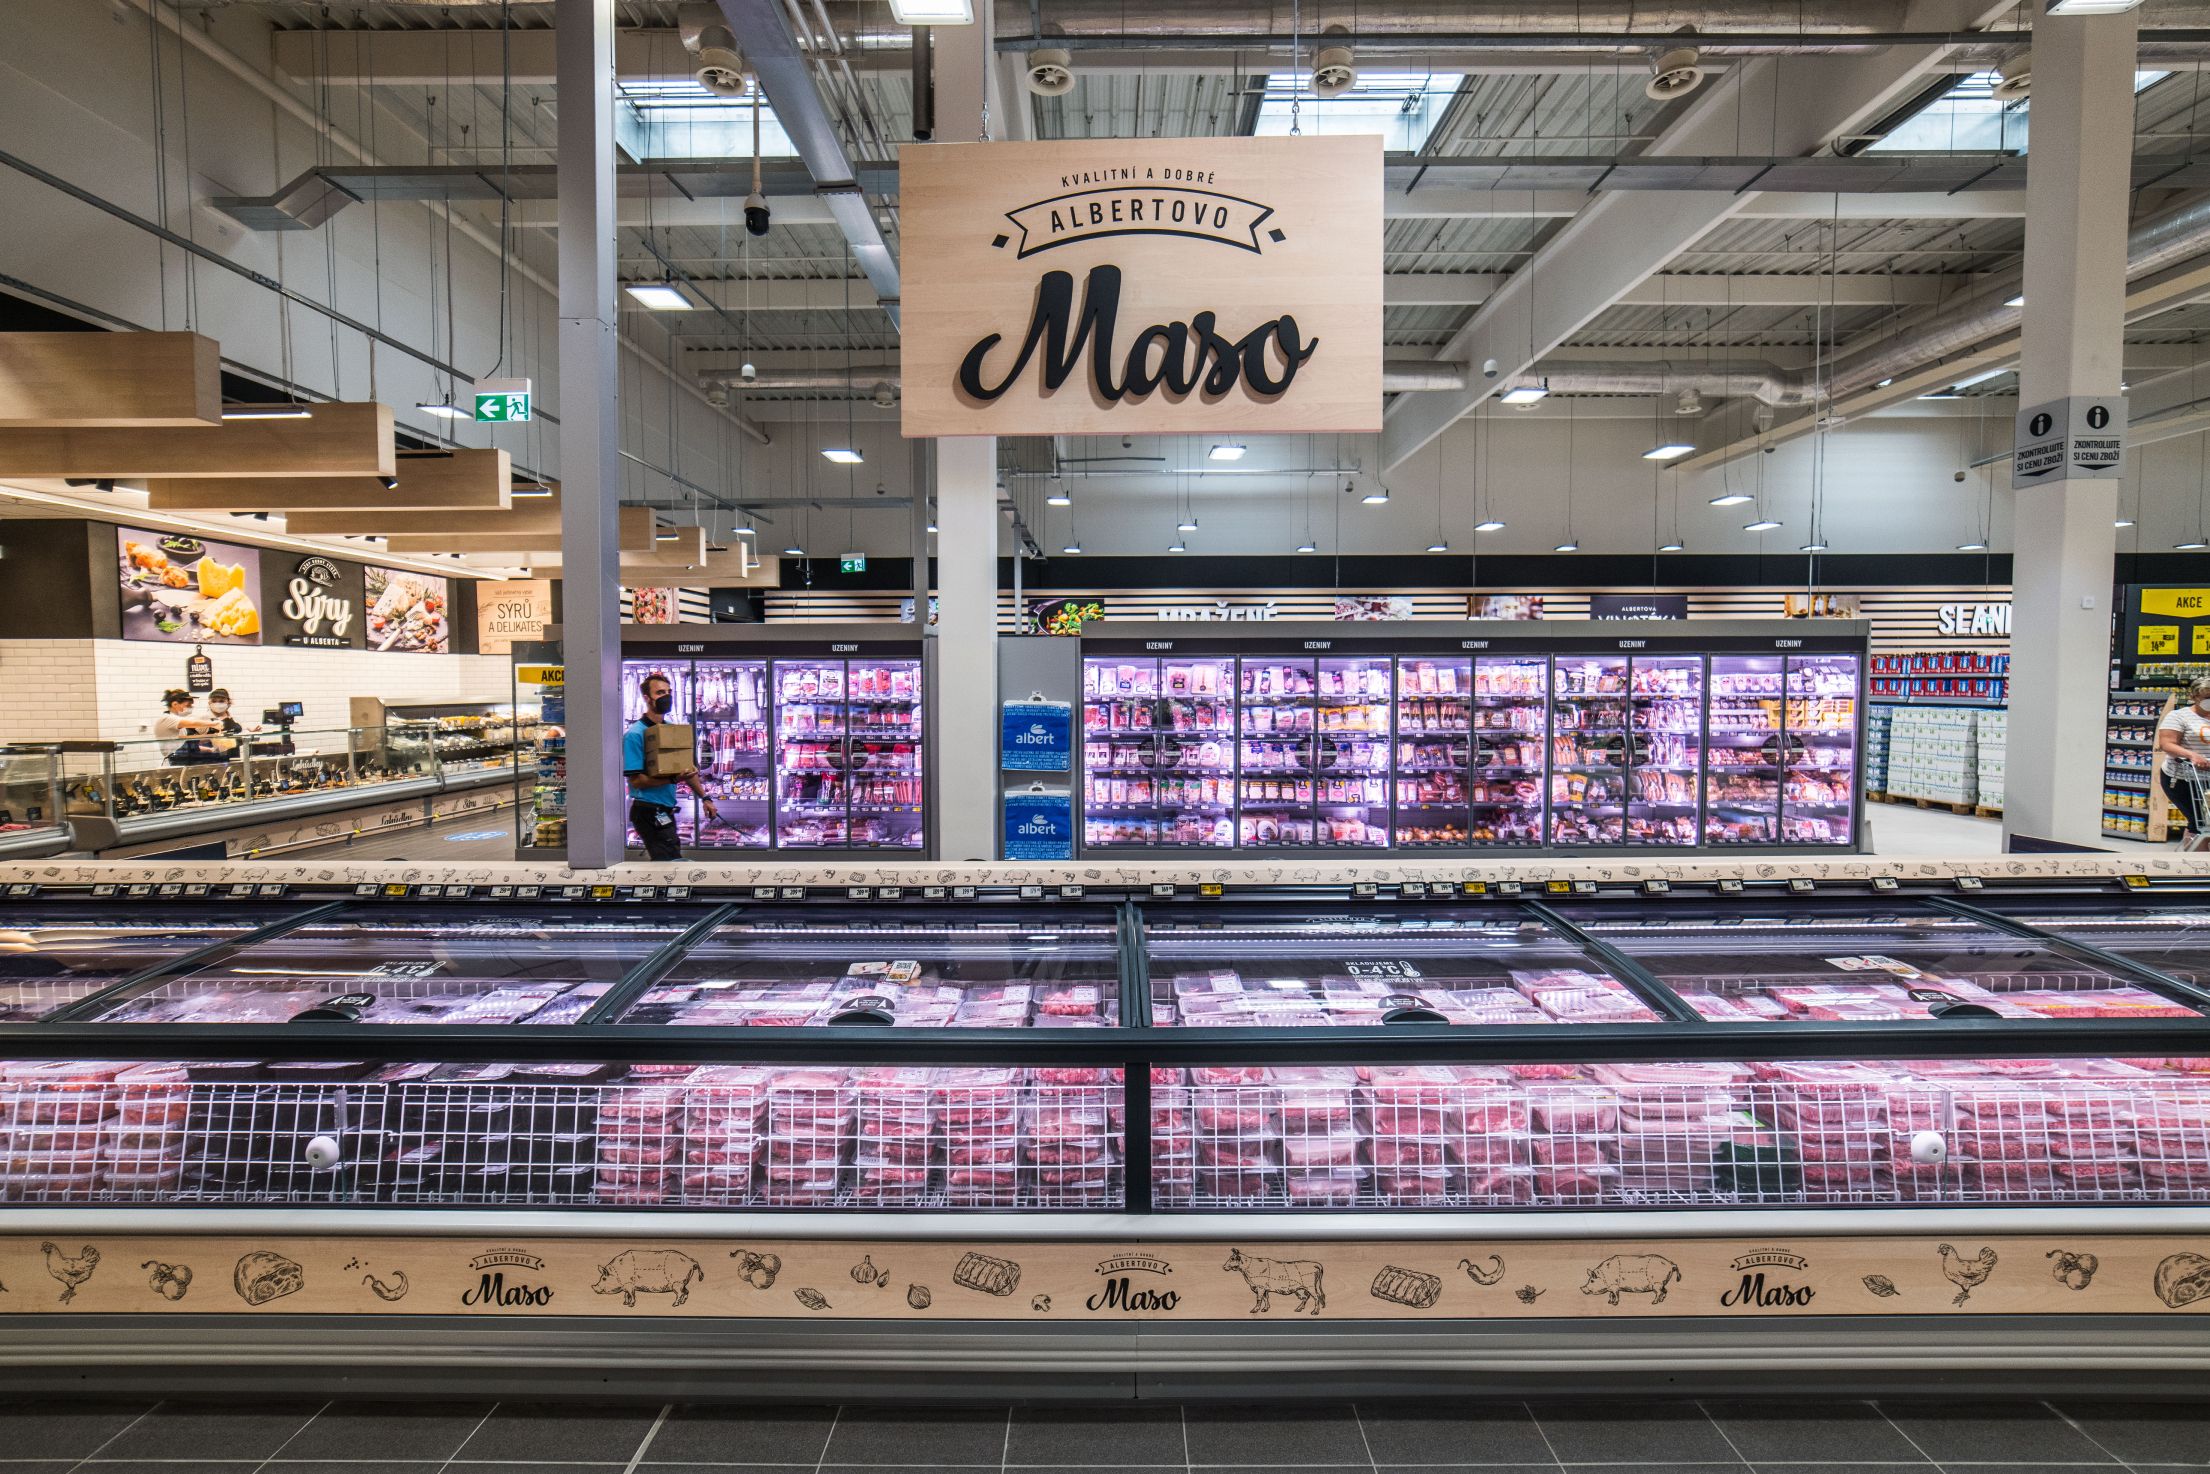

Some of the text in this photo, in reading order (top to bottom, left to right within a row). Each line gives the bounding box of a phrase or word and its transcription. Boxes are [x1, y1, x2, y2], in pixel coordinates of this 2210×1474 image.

[1061, 166, 1215, 188] KVALITNÍ A DOBRÉ
[1051, 199, 1229, 233] ALBERTOVO
[960, 264, 1319, 401] Maso
[2074, 440, 2120, 449] ZKONTROLUJTE
[2018, 442, 2064, 460] ZKONTROLUJTE
[2073, 450, 2120, 460] SI CENU ZBOŽÍ
[2017, 452, 2064, 472] SI CENU ZBOŽÍ
[282, 578, 353, 636] Sýry
[2176, 597, 2202, 608] AKCE
[498, 599, 531, 619] SÝRŮ
[489, 621, 542, 632] A DELIKATES
[311, 637, 339, 646] ALBERTA
[1146, 642, 1173, 650] UZENINY
[1304, 641, 1331, 649] UZENINY
[1462, 640, 1488, 649] UZENINY
[1775, 640, 1802, 648] UZENINY
[1016, 733, 1054, 744] albert
[1018, 823, 1056, 835] albert
[484, 1256, 531, 1264] ALBERTOVO
[1110, 1260, 1157, 1269] ALBERTOVO
[1746, 1256, 1794, 1264] ALBERTOVO
[462, 1273, 554, 1306] Maso
[1086, 1278, 1181, 1311] Maso
[1720, 1273, 1816, 1307] Maso
